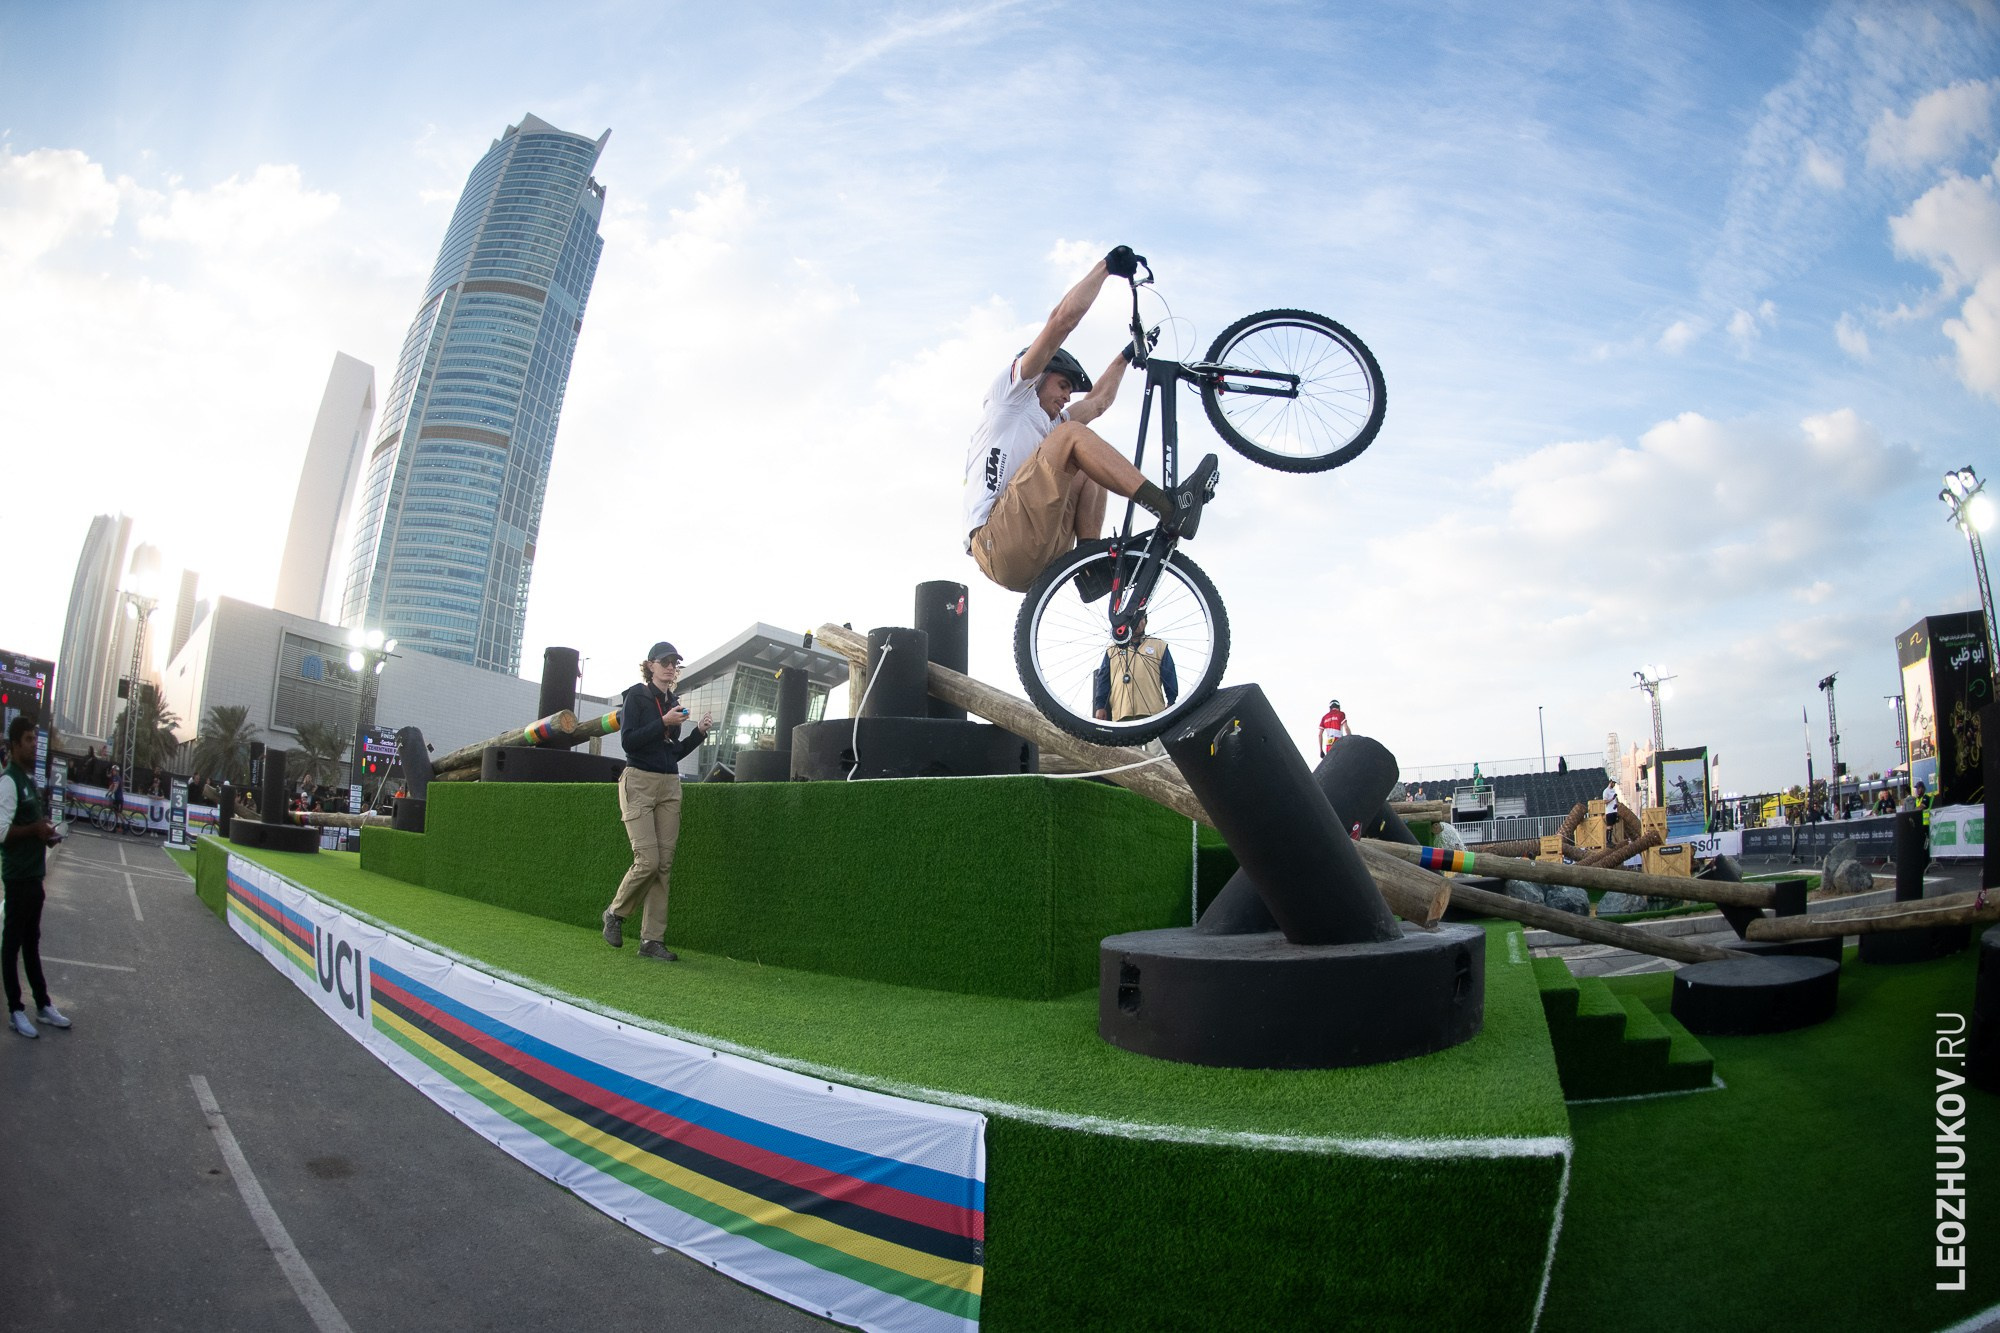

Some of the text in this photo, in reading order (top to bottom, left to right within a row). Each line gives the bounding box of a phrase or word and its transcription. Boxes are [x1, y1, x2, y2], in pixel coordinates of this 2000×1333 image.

[986, 447, 1001, 493] KTM
[998, 453, 1007, 480] INDUSTRIES
[1951, 642, 1985, 670] أبو ظبي
[55, 773, 62, 787] 2
[175, 795, 183, 808] 3
[316, 925, 364, 1020] UCI
